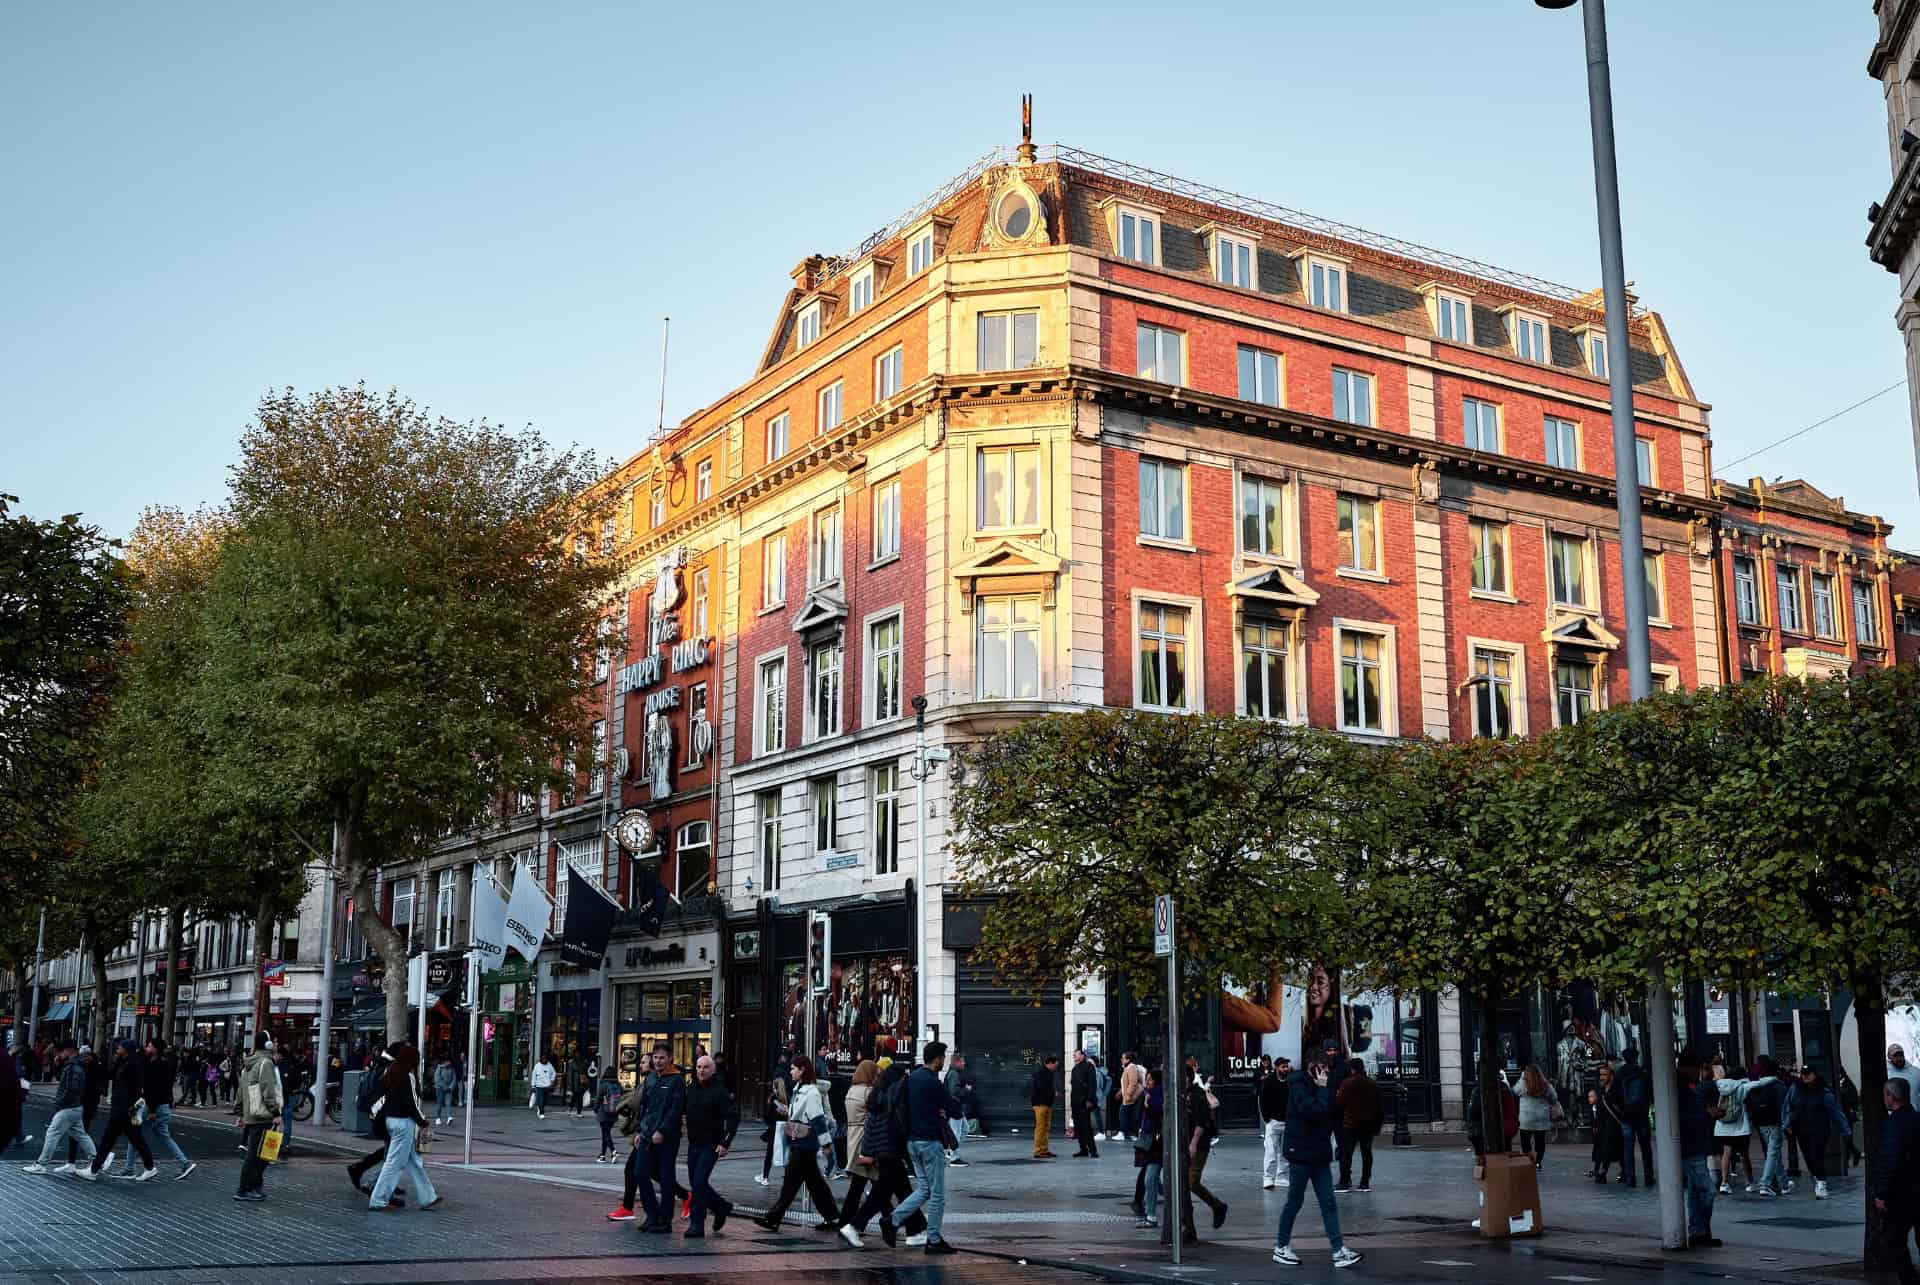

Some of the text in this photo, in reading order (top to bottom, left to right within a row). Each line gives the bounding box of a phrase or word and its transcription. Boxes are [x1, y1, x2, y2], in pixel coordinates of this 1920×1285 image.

[622, 638, 707, 693] HAPPY RING
[645, 686, 681, 712] HOUSE
[506, 918, 538, 946] SEIKO
[837, 1048, 851, 1062] Sale
[1228, 1055, 1261, 1069] To Let
